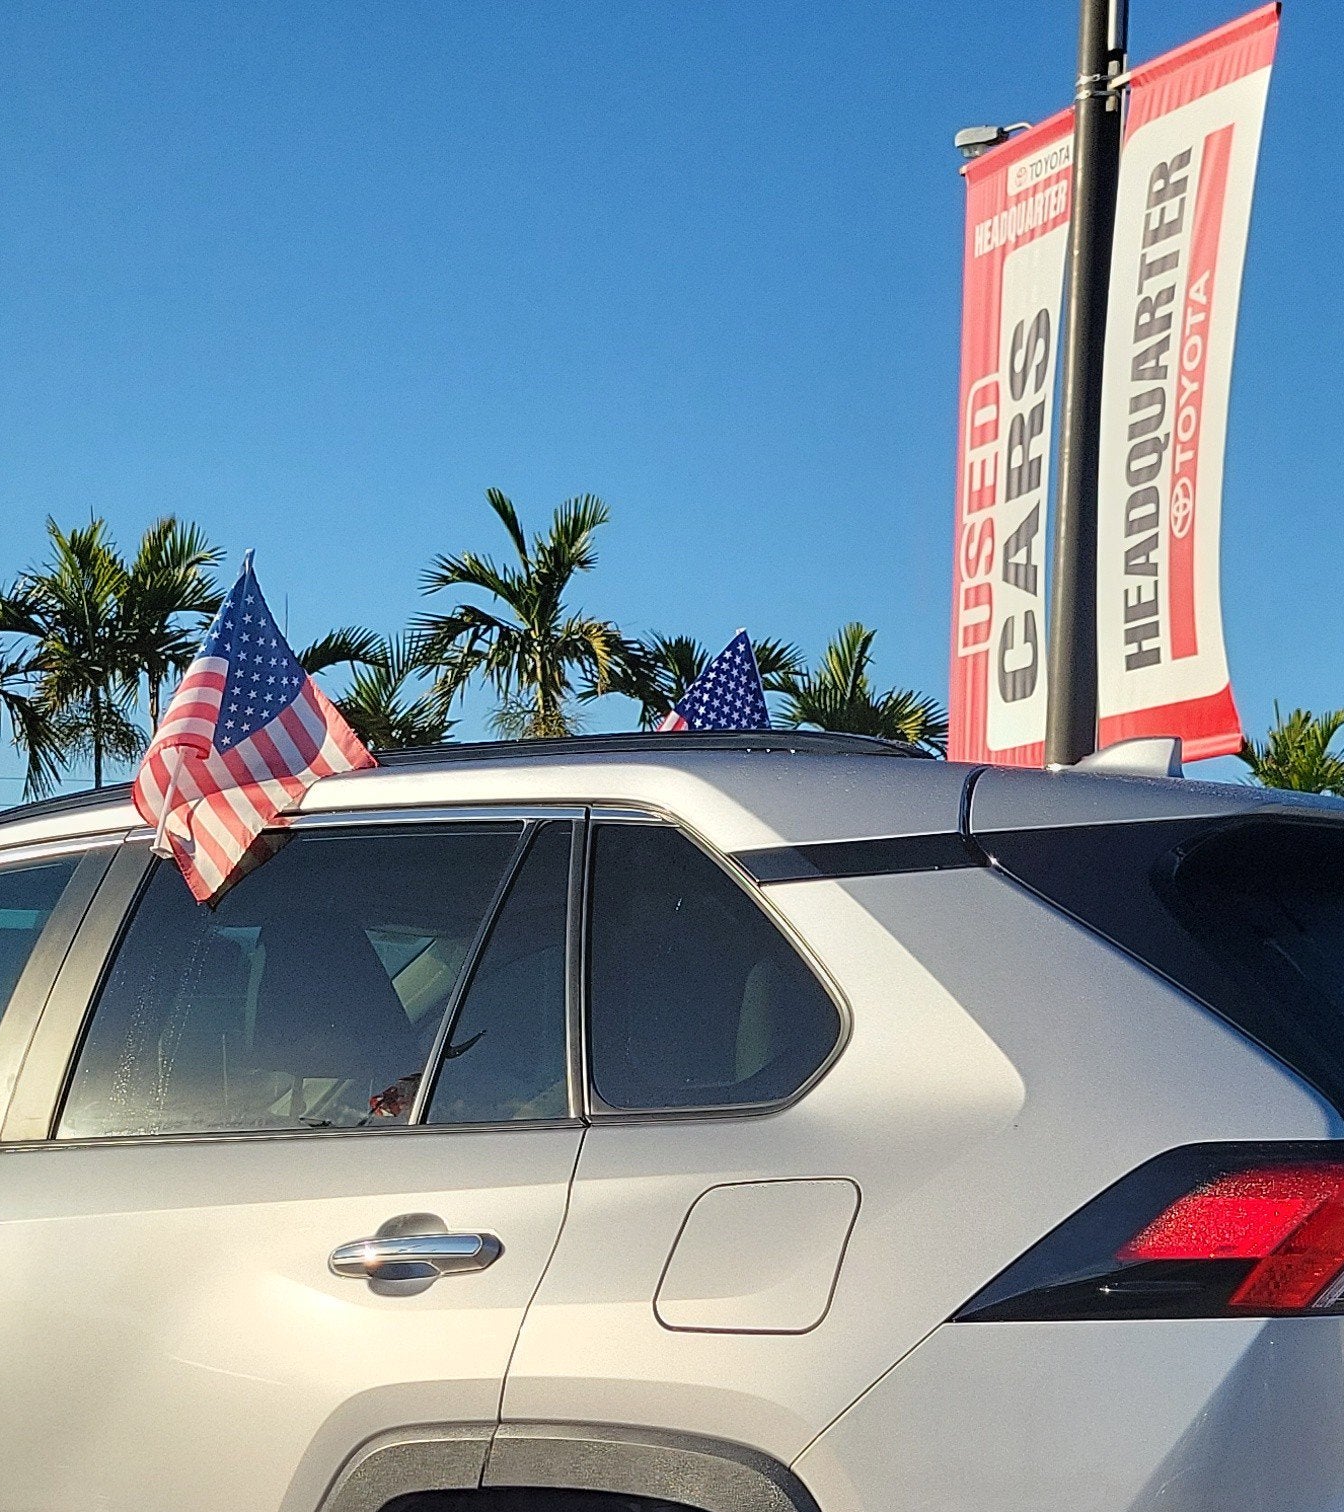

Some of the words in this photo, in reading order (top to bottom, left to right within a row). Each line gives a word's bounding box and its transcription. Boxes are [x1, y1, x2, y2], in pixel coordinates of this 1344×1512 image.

[975, 179, 1067, 258] HEADQUARTER
[1030, 145, 1070, 181] TOYOTA
[1124, 146, 1193, 672] HEADQUARTER
[1175, 269, 1212, 474] TOYOTA
[958, 372, 1000, 657] USED
[998, 308, 1051, 703] CARS
